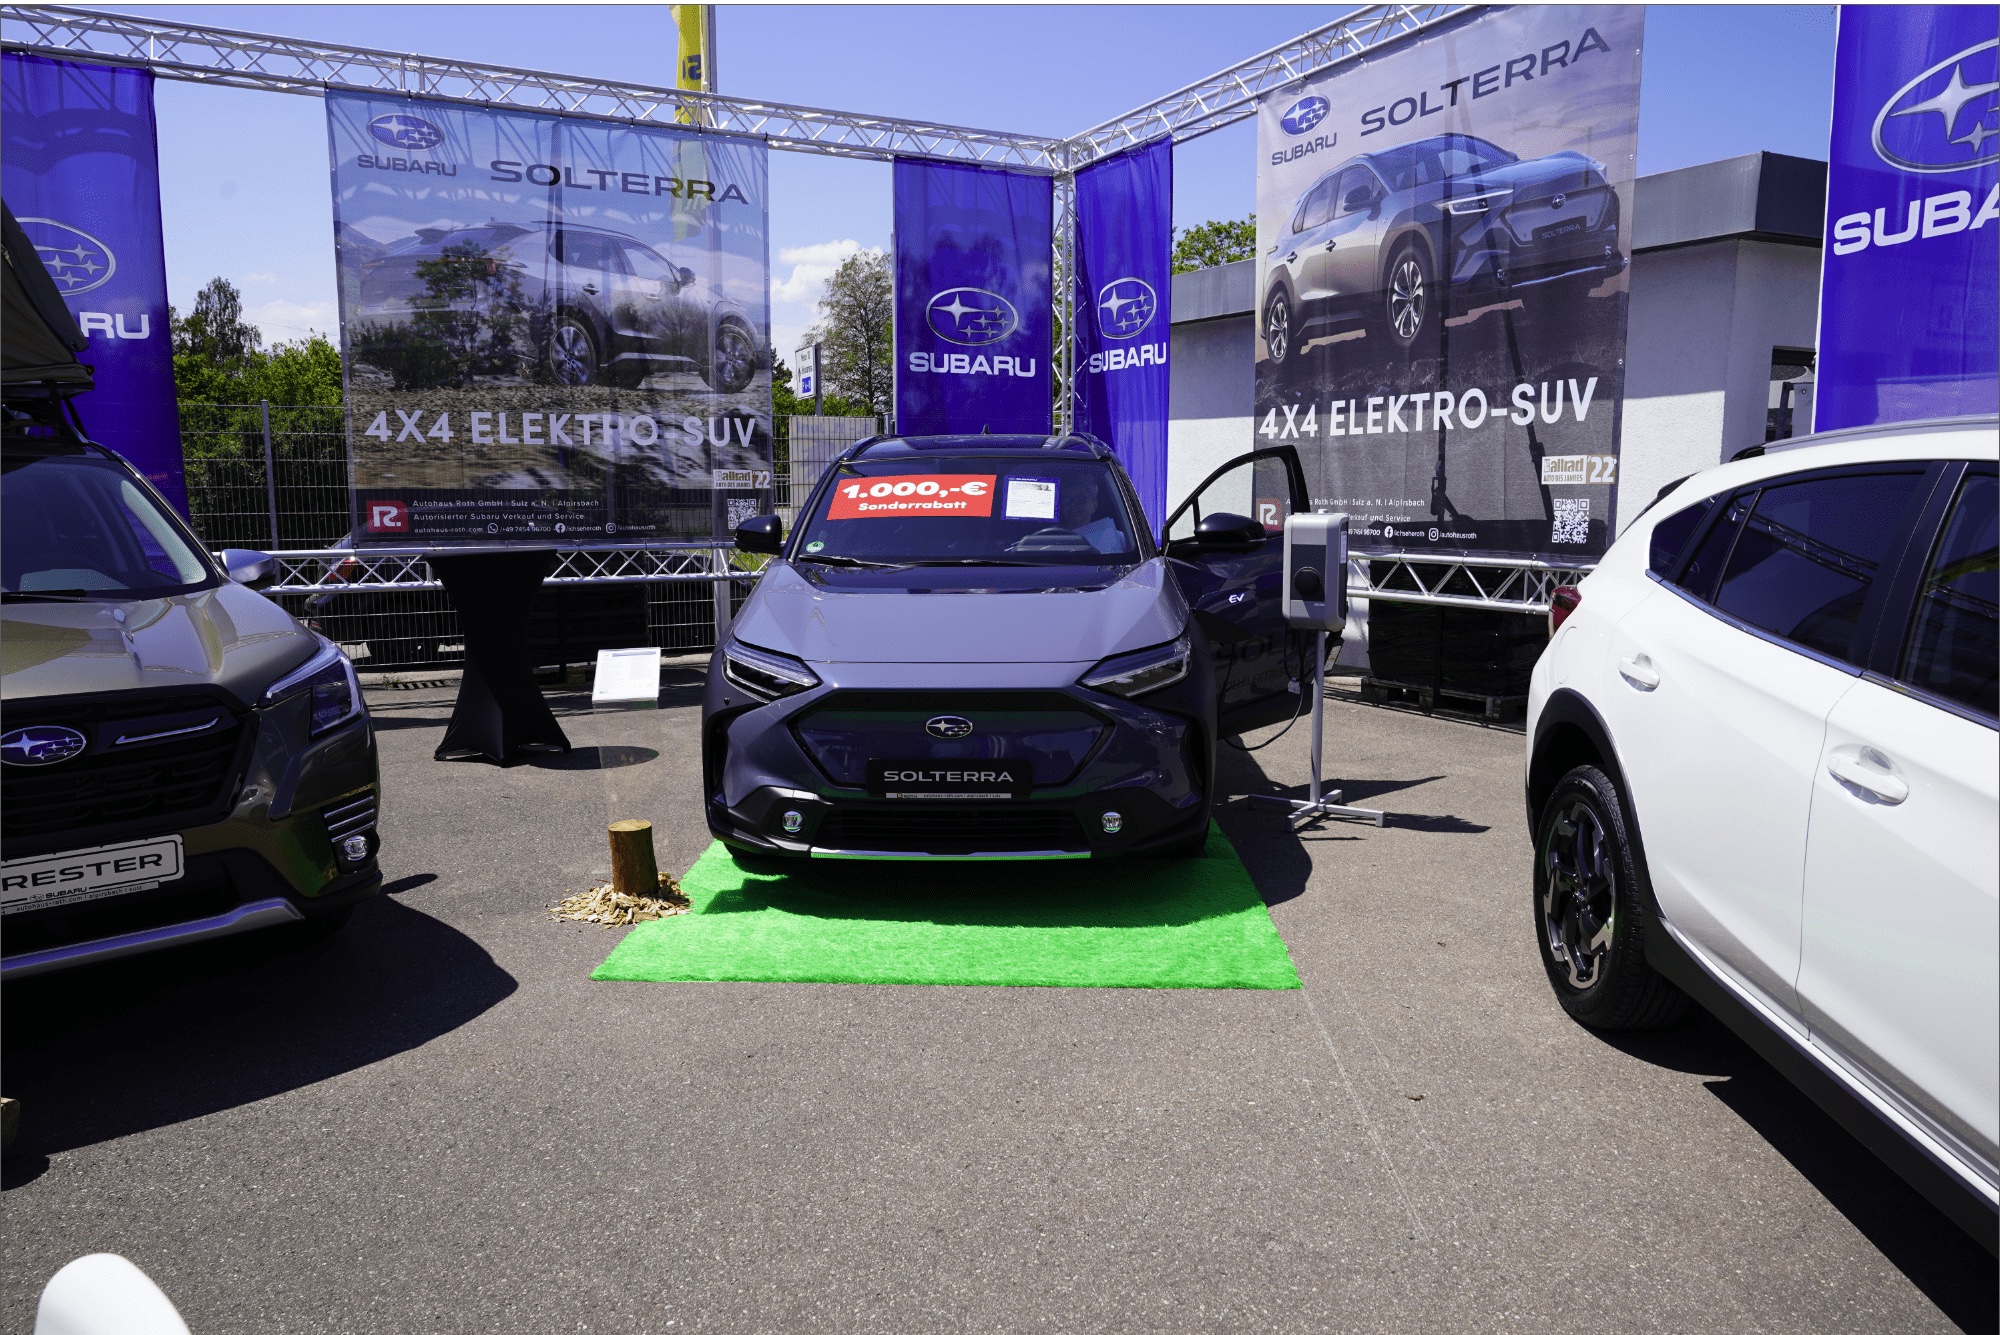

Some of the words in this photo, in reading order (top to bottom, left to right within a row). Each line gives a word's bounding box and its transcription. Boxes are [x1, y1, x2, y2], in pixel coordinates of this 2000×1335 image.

[1360, 27, 1612, 137] SOLTERRA
[1272, 132, 1337, 166] SUBARU
[357, 154, 457, 177] SUBARU
[490, 160, 749, 205] SOLTERRA
[1541, 223, 1581, 239] SOLTERRA
[909, 351, 1036, 378] SUBARU
[1089, 341, 1167, 374] SUBARU
[1258, 403, 1319, 439] 4X4
[1329, 377, 1599, 437] ELEKTRO-SUV
[364, 409, 454, 443] 4X4
[470, 411, 757, 448] ELEKTRO-SUV
[1550, 458, 1584, 473] allrad
[722, 471, 751, 481] allrad
[1555, 474, 1564, 482] DES
[1564, 474, 1583, 482] JAHRES
[842, 481, 988, 499] 1.000,-€
[558, 500, 599, 509] Alpirsbach
[858, 500, 967, 511] Sonderrabatt
[1314, 498, 1329, 506] Roth
[1330, 498, 1348, 506] GmbH
[1388, 499, 1425, 508] Alpirsbach
[413, 513, 468, 521] Autorisierter
[470, 513, 500, 521] Subaru
[1385, 514, 1411, 522] Service
[1228, 593, 1245, 604] EV
[884, 770, 1014, 782] SOLTERRA
[1, 853, 163, 892] RESTER
[16, 895, 83, 912] autohaus-roth.com
[88, 888, 123, 900] alpirsbach
[129, 885, 143, 893] sulz
[45, 886, 87, 899] SUBARU
